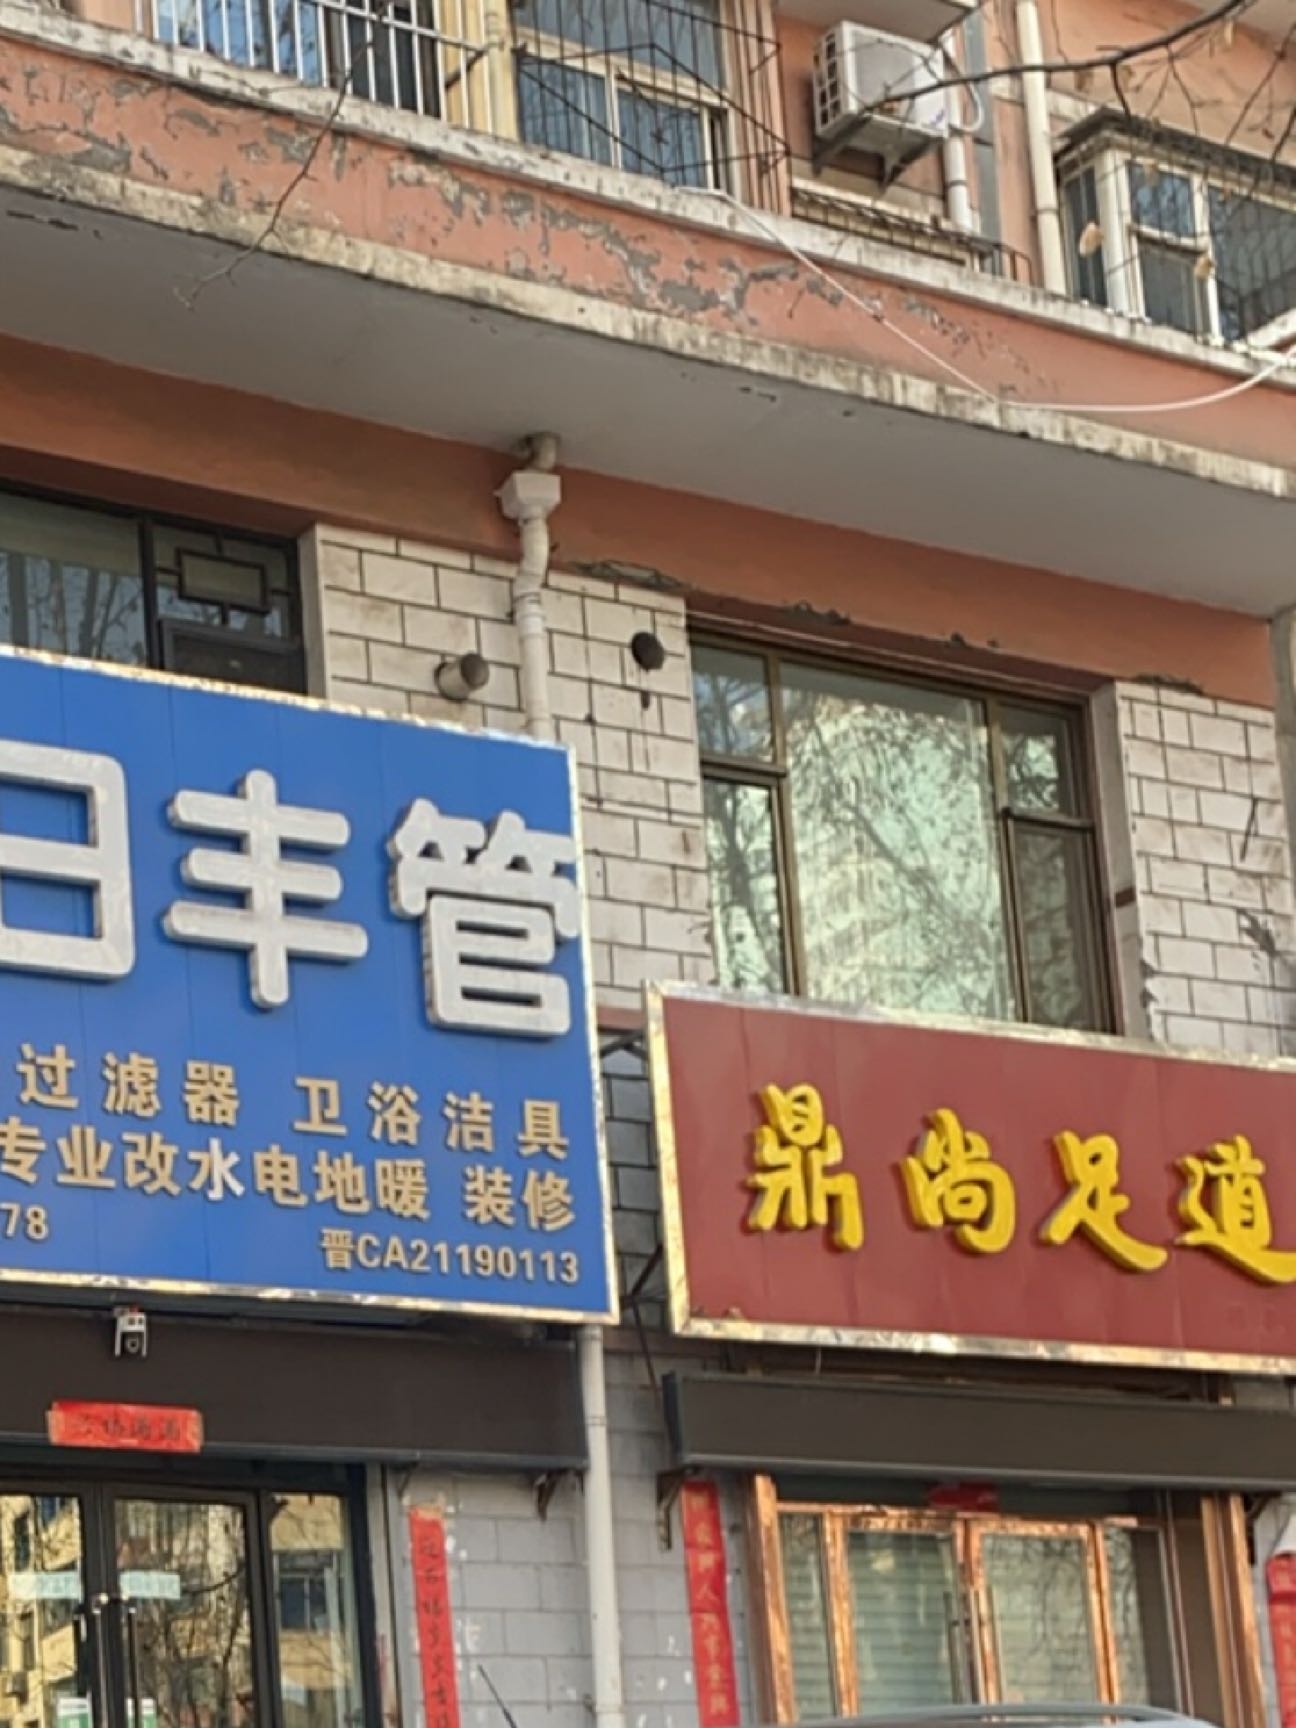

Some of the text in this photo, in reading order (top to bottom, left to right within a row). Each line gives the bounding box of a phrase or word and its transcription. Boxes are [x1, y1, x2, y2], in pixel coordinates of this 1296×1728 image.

[293, 1076, 570, 1160] 卫浴洁具
[463, 1164, 577, 1233] 装修
[743, 1082, 1296, 1285] 鼎尚足道
[319, 1226, 579, 1285] 晋CA21190113
